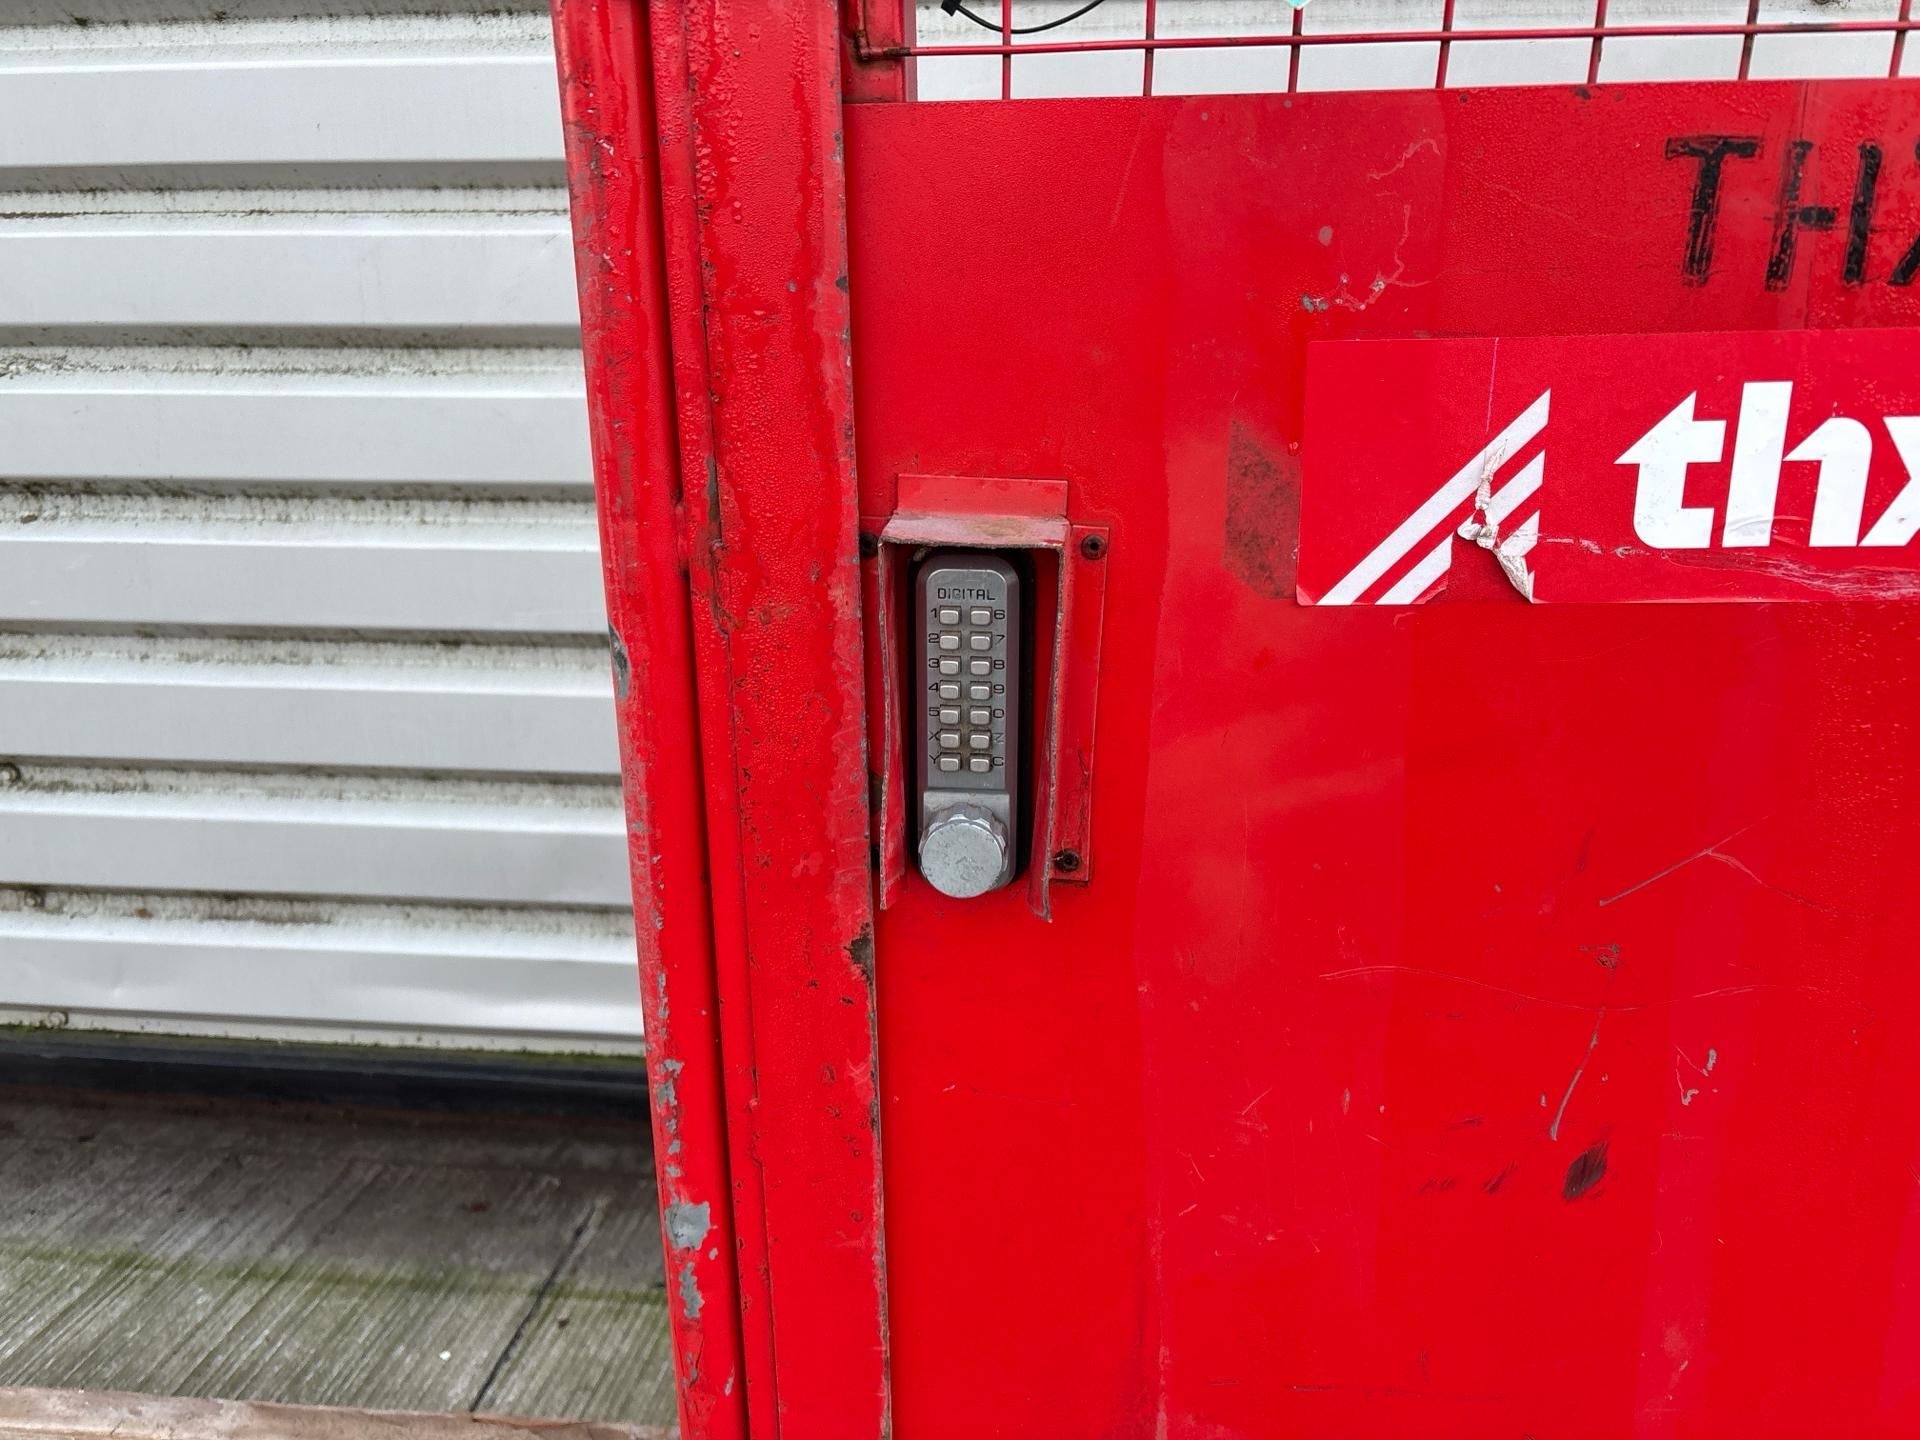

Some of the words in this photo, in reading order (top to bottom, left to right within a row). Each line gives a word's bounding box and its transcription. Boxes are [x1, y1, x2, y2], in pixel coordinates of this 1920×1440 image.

[937, 588, 996, 601] DIGITAL
[930, 608, 938, 618] 1
[993, 609, 1006, 620] 6
[928, 633, 940, 644] 2
[995, 634, 1006, 645] 7
[928, 658, 940, 668] 3
[993, 659, 1005, 670] 8
[928, 682, 940, 692] 4
[993, 684, 1005, 694] 9
[928, 707, 940, 717] 5
[928, 730, 940, 741] X
[928, 754, 941, 764] Y
